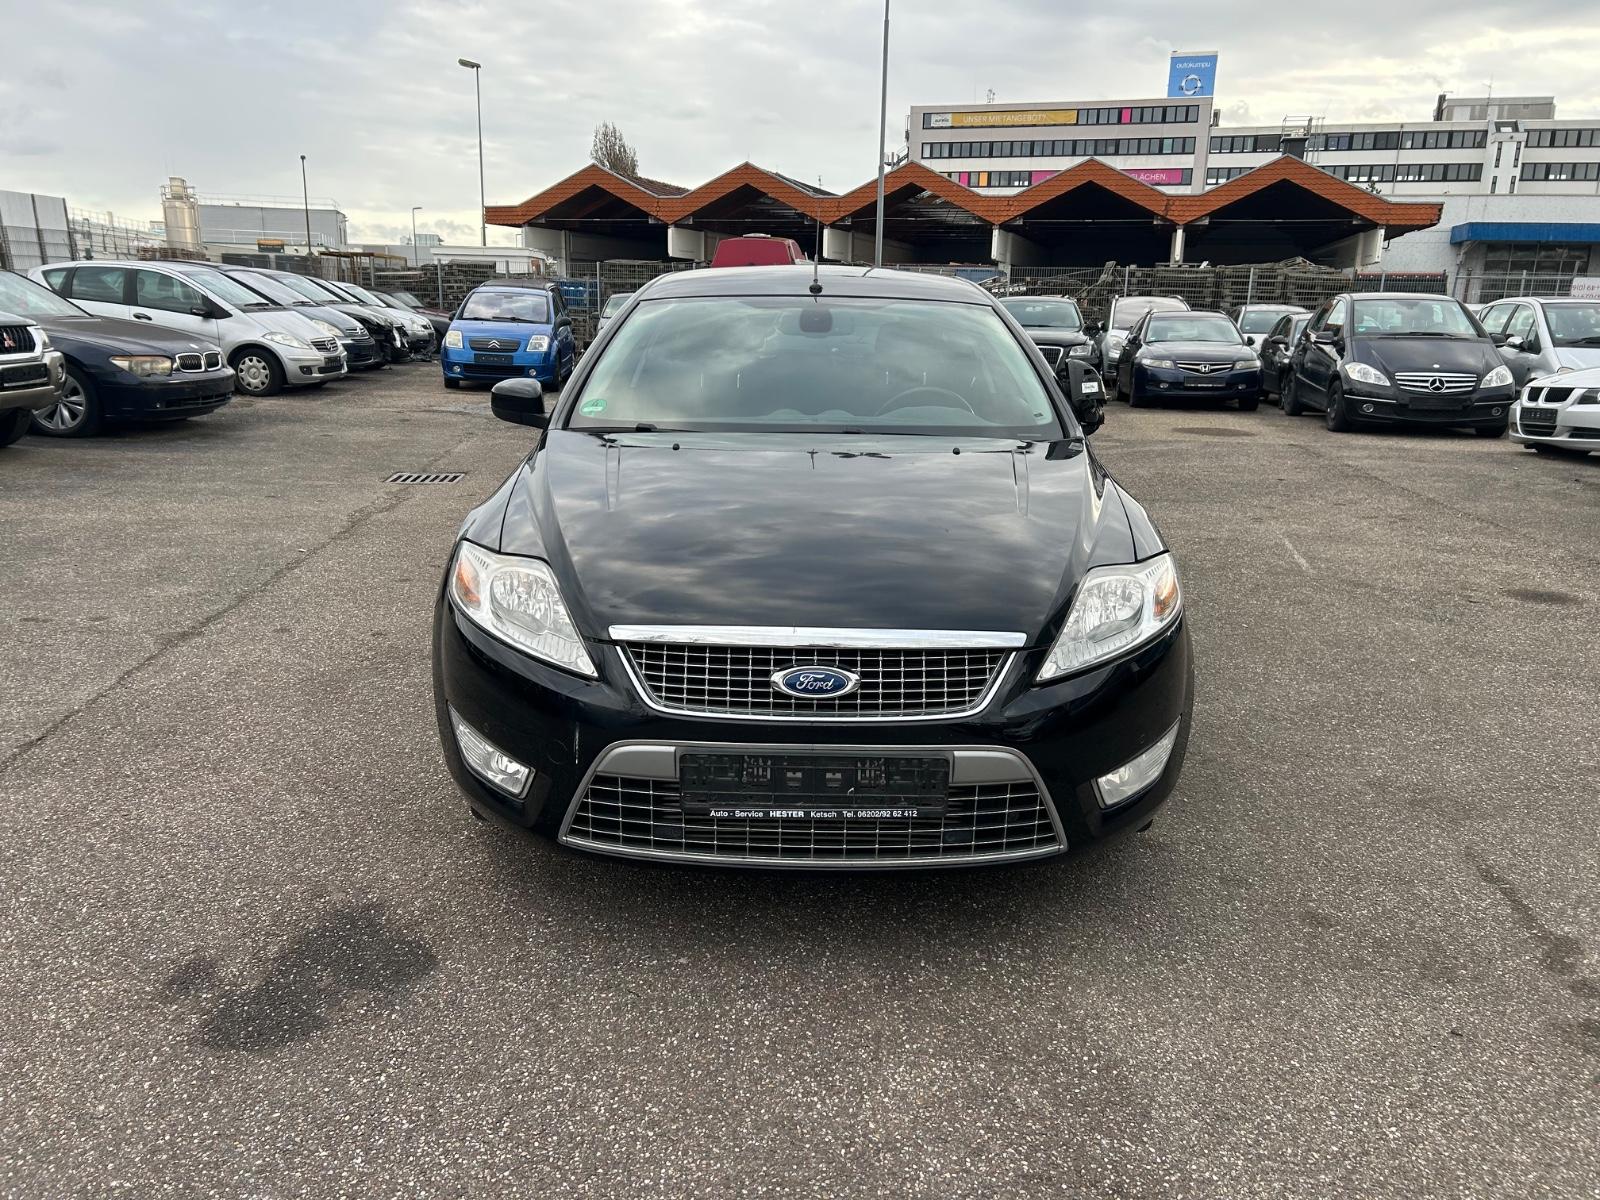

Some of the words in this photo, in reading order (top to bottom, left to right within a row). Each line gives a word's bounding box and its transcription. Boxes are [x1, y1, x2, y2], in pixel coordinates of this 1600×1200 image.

[963, 114, 987, 123] UNSER
[796, 673, 834, 690] Ford
[735, 810, 763, 818] Service
[769, 810, 805, 818] HESTER
[810, 810, 837, 818] Ketsch
[842, 810, 856, 818] Tel.
[857, 810, 891, 818] 06202/92
[892, 810, 902, 818] 62
